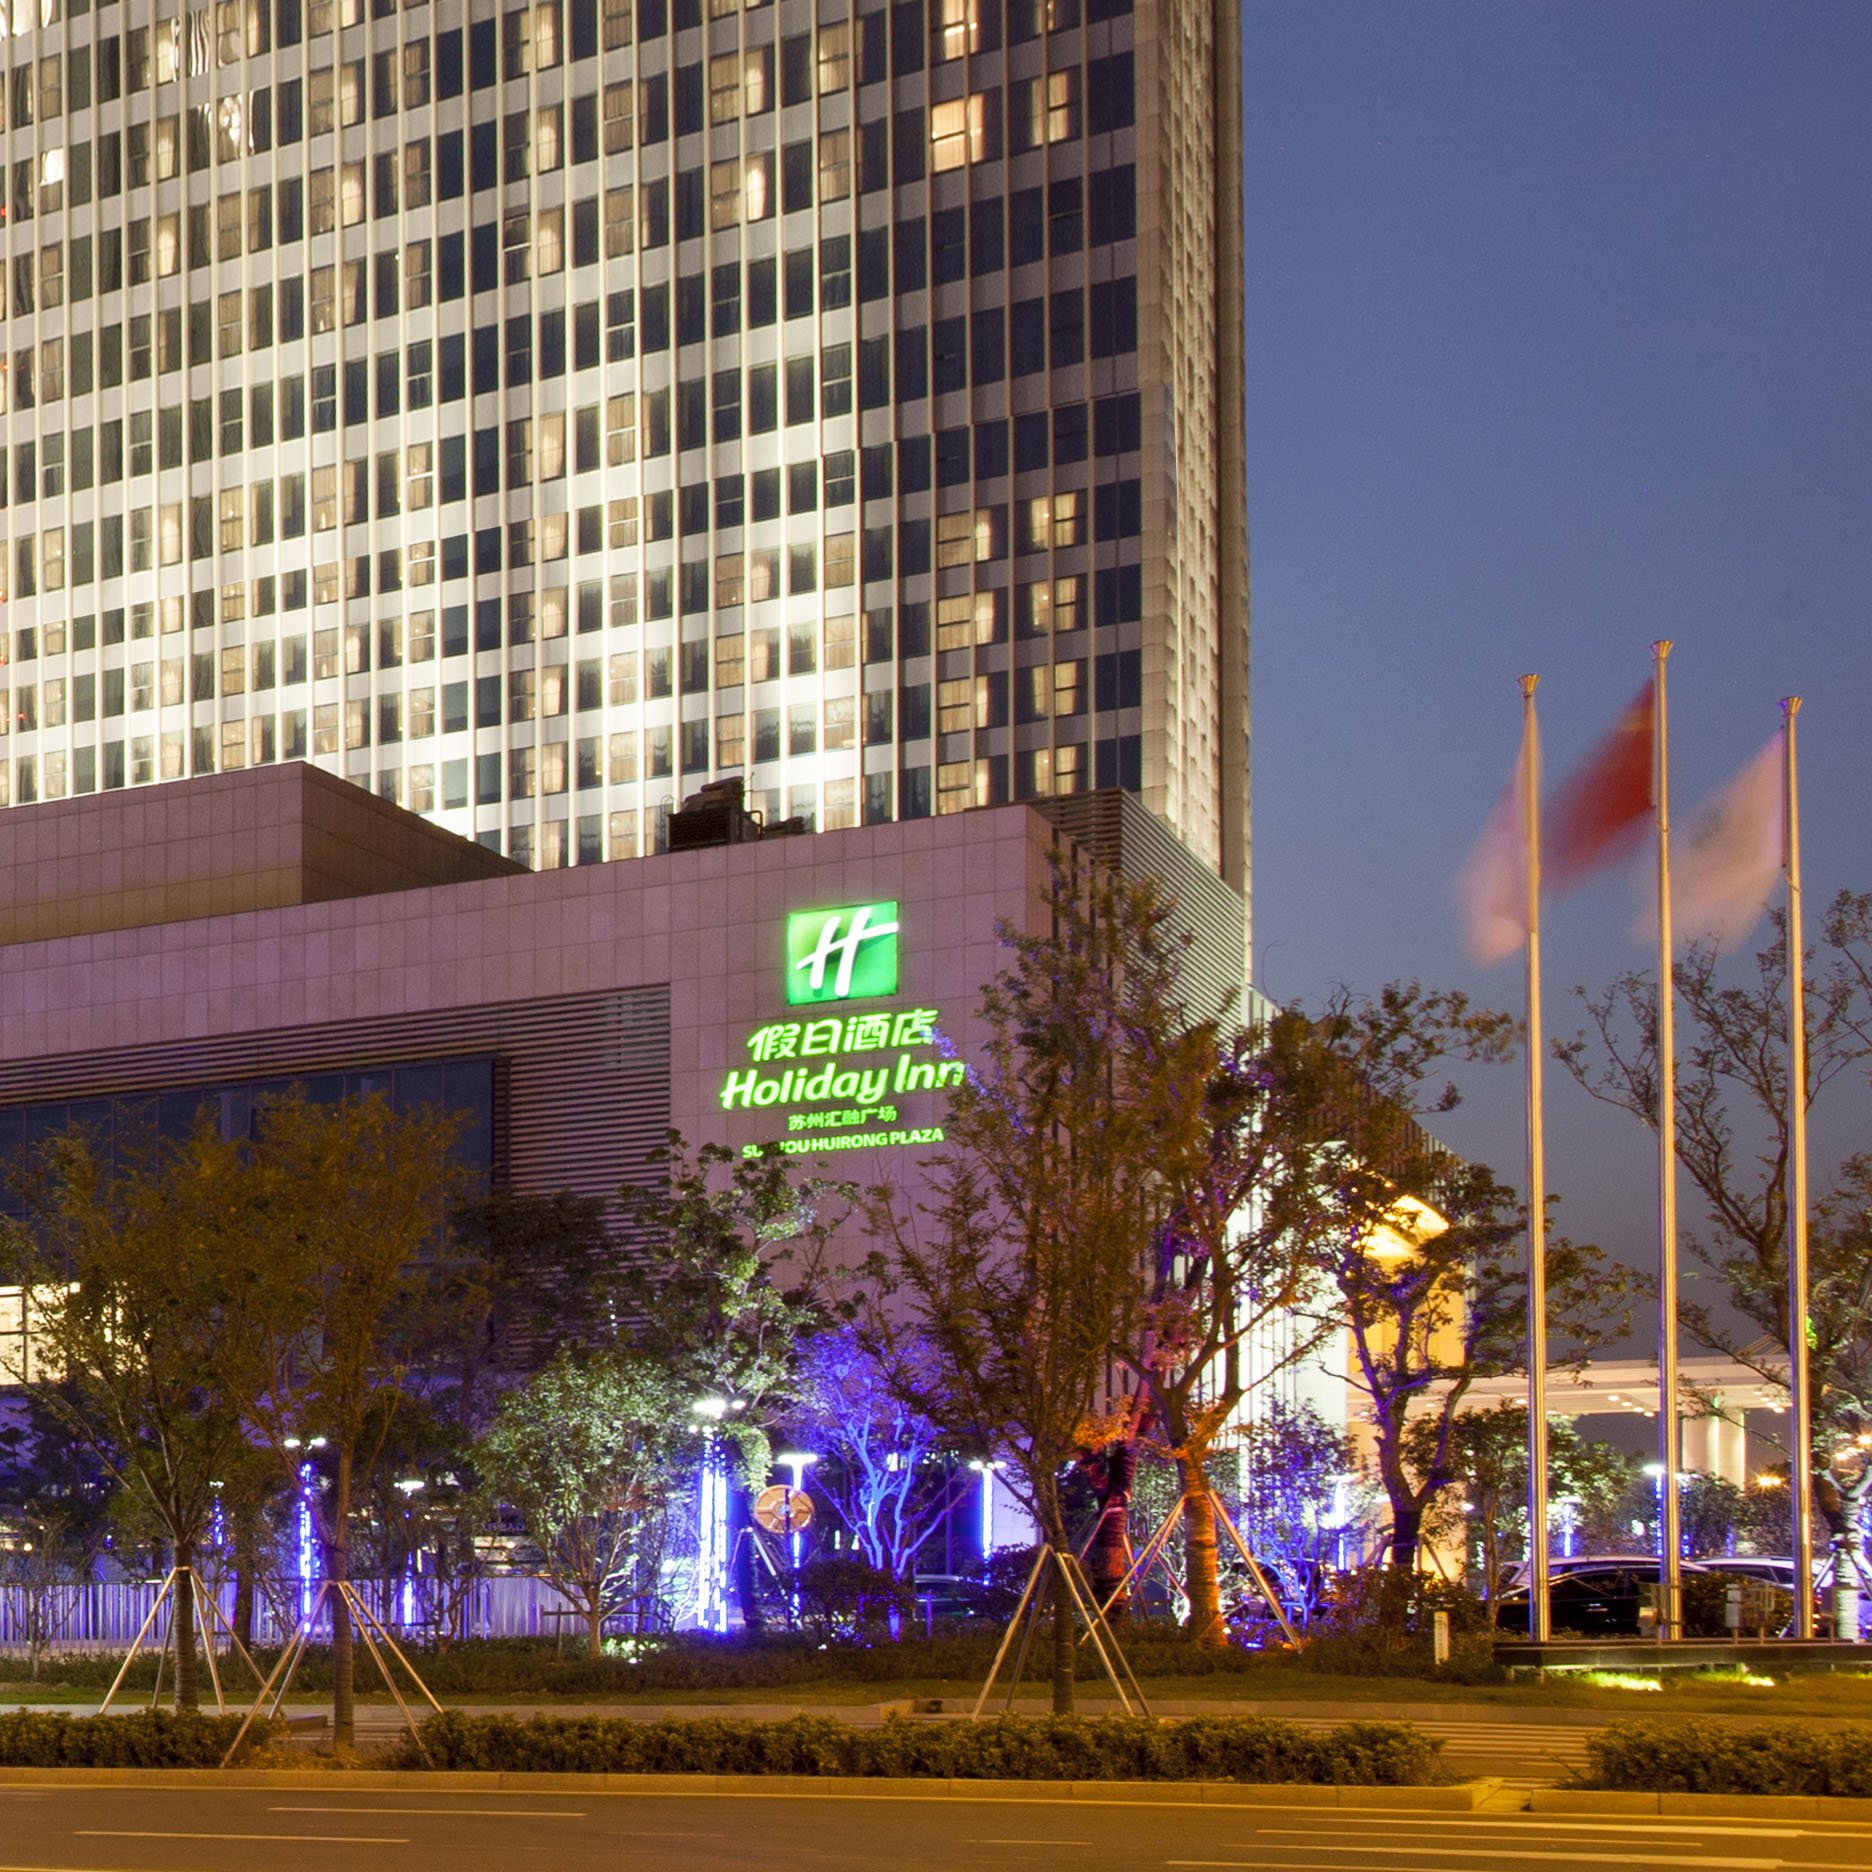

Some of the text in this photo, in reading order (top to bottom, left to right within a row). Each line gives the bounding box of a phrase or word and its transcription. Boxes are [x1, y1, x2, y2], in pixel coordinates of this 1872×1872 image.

[746, 1008, 939, 1063] 假日酒店
[720, 1054, 966, 1111] Holiday Inn
[787, 1104, 898, 1132] 苏州汇融广场
[742, 1127, 945, 1159] SUOU HUIRONG PLAZA
